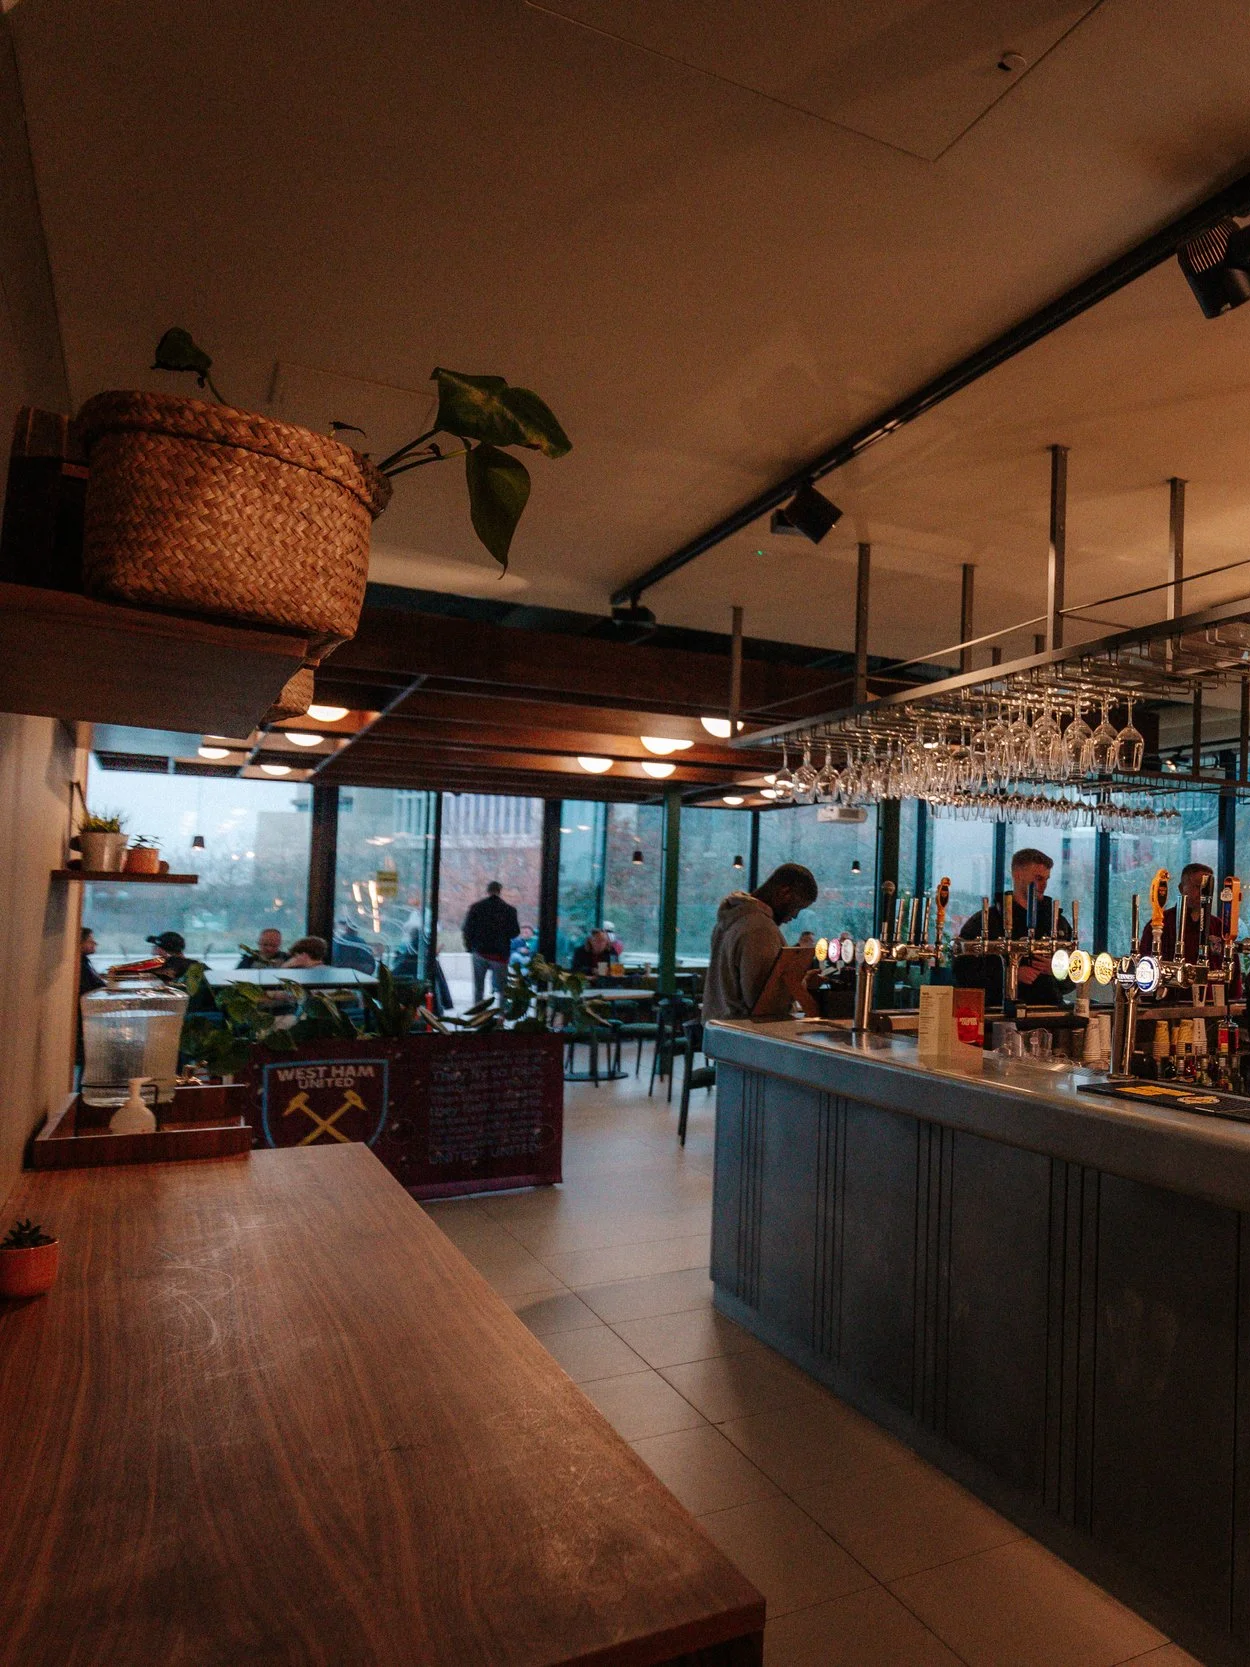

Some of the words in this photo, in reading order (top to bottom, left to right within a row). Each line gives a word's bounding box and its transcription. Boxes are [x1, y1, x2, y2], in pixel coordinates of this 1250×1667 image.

[277, 1066, 327, 1081] WEST
[331, 1065, 375, 1078] HAM
[298, 1077, 355, 1089] UNITED
